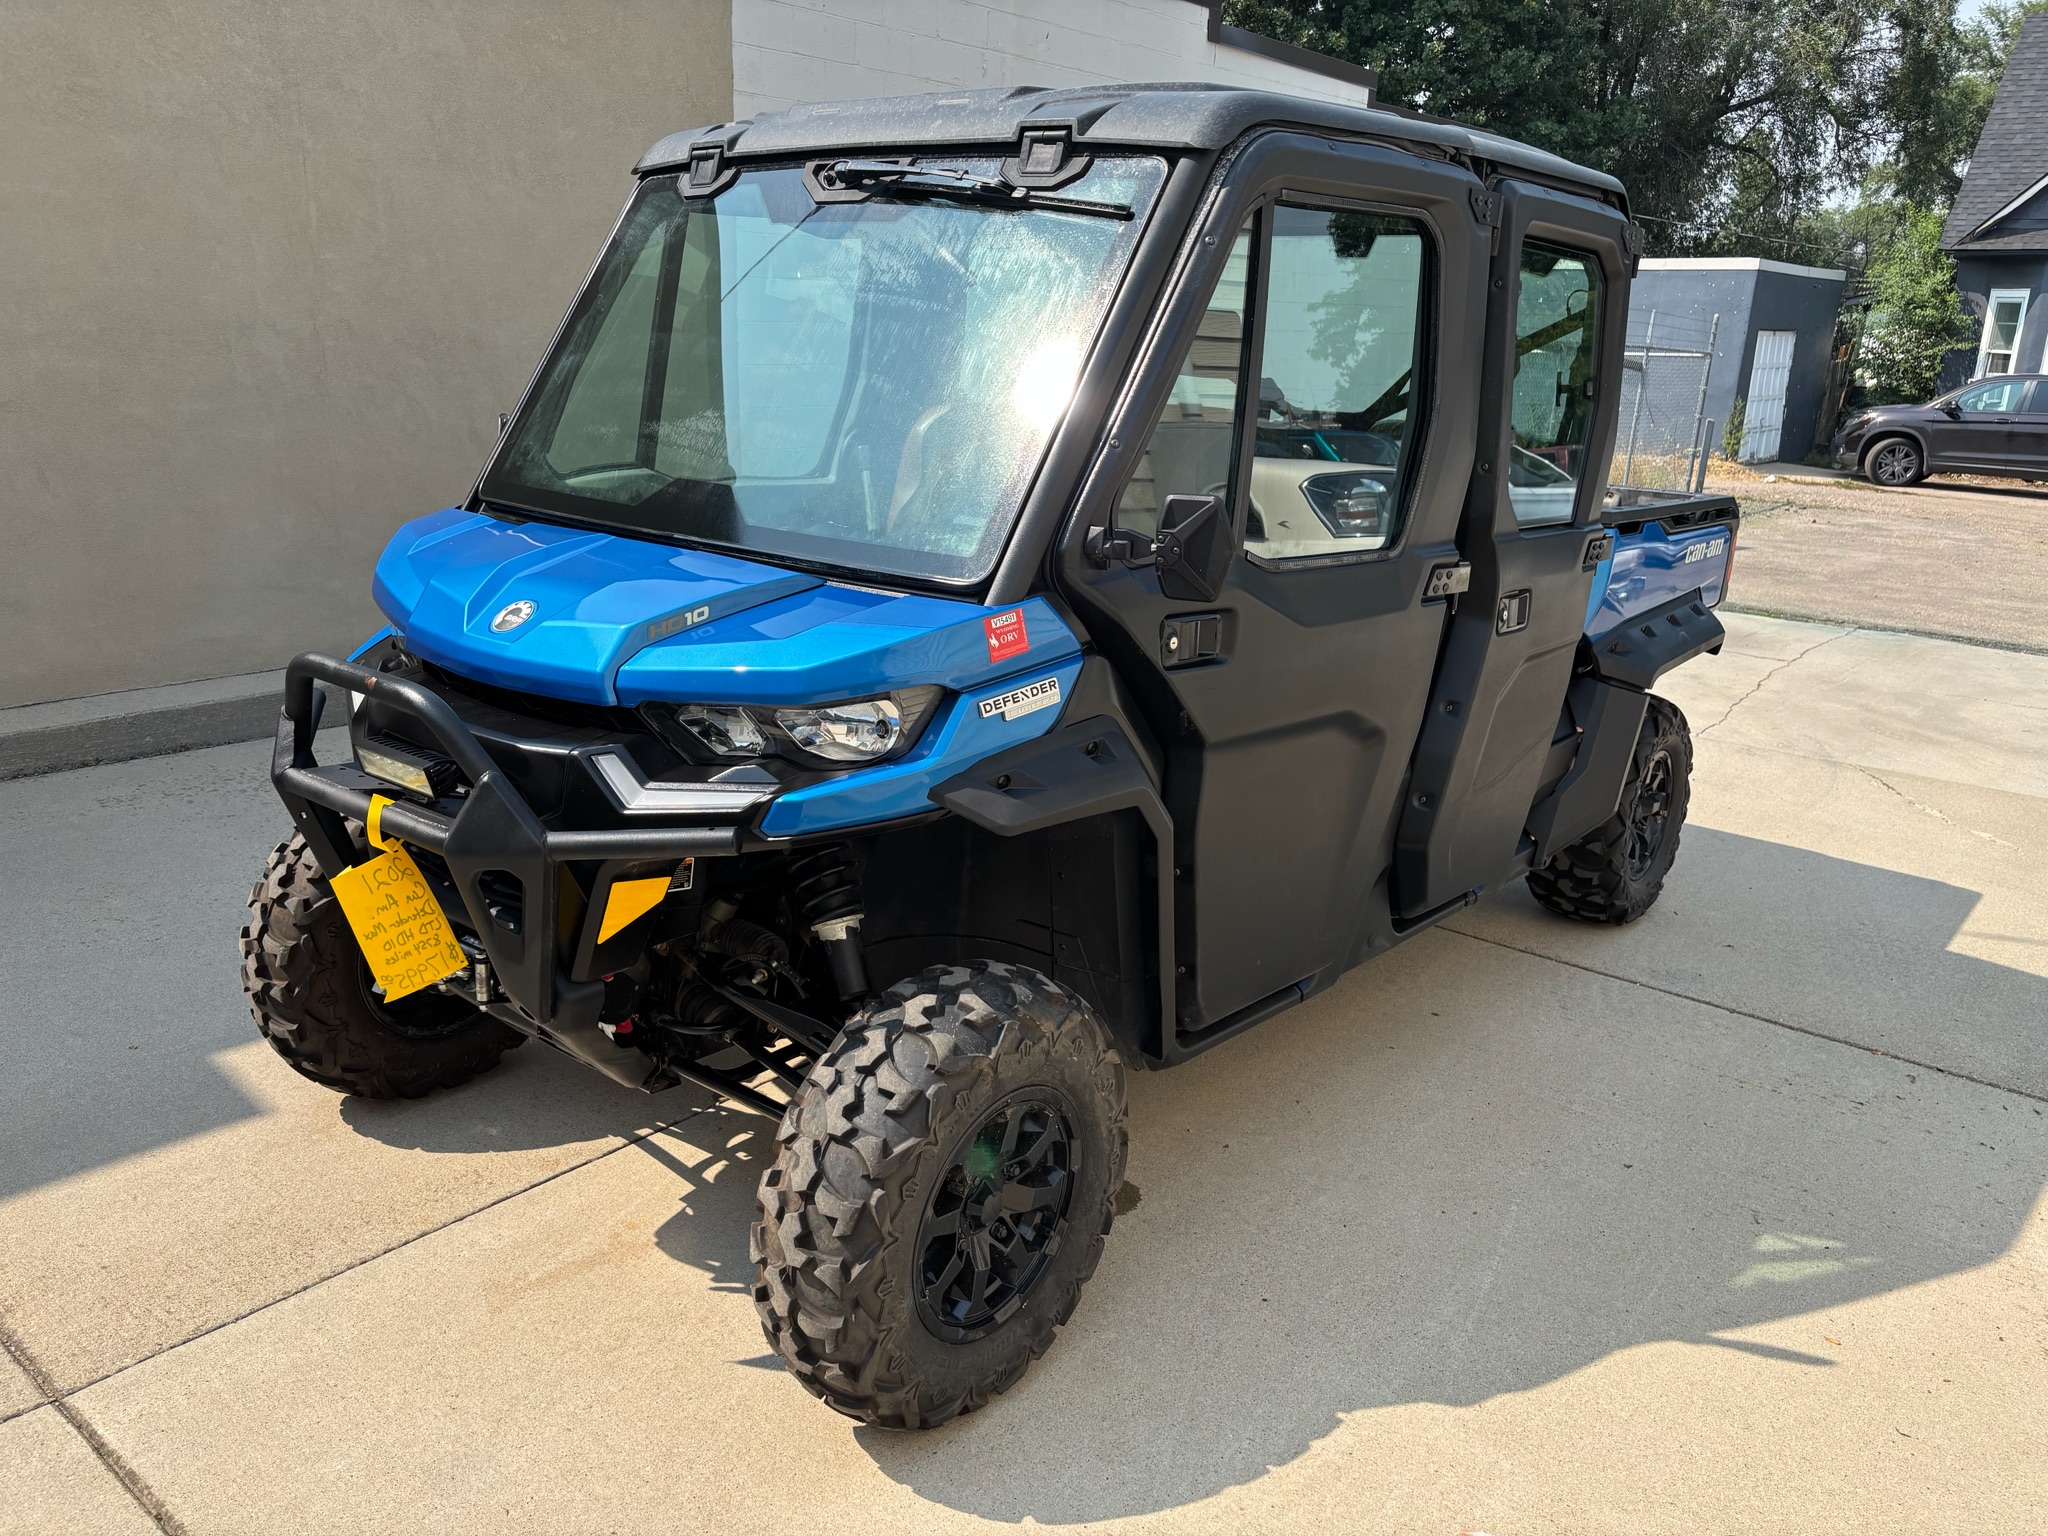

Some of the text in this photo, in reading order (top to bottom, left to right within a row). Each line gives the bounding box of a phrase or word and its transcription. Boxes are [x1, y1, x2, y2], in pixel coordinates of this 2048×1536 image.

[1685, 538, 1725, 564] can-am
[649, 606, 709, 639] HD10
[993, 614, 1015, 627] V15491
[996, 624, 1019, 634] WYOMING
[1000, 630, 1019, 644] ORV
[982, 679, 1057, 714] DEFENDER
